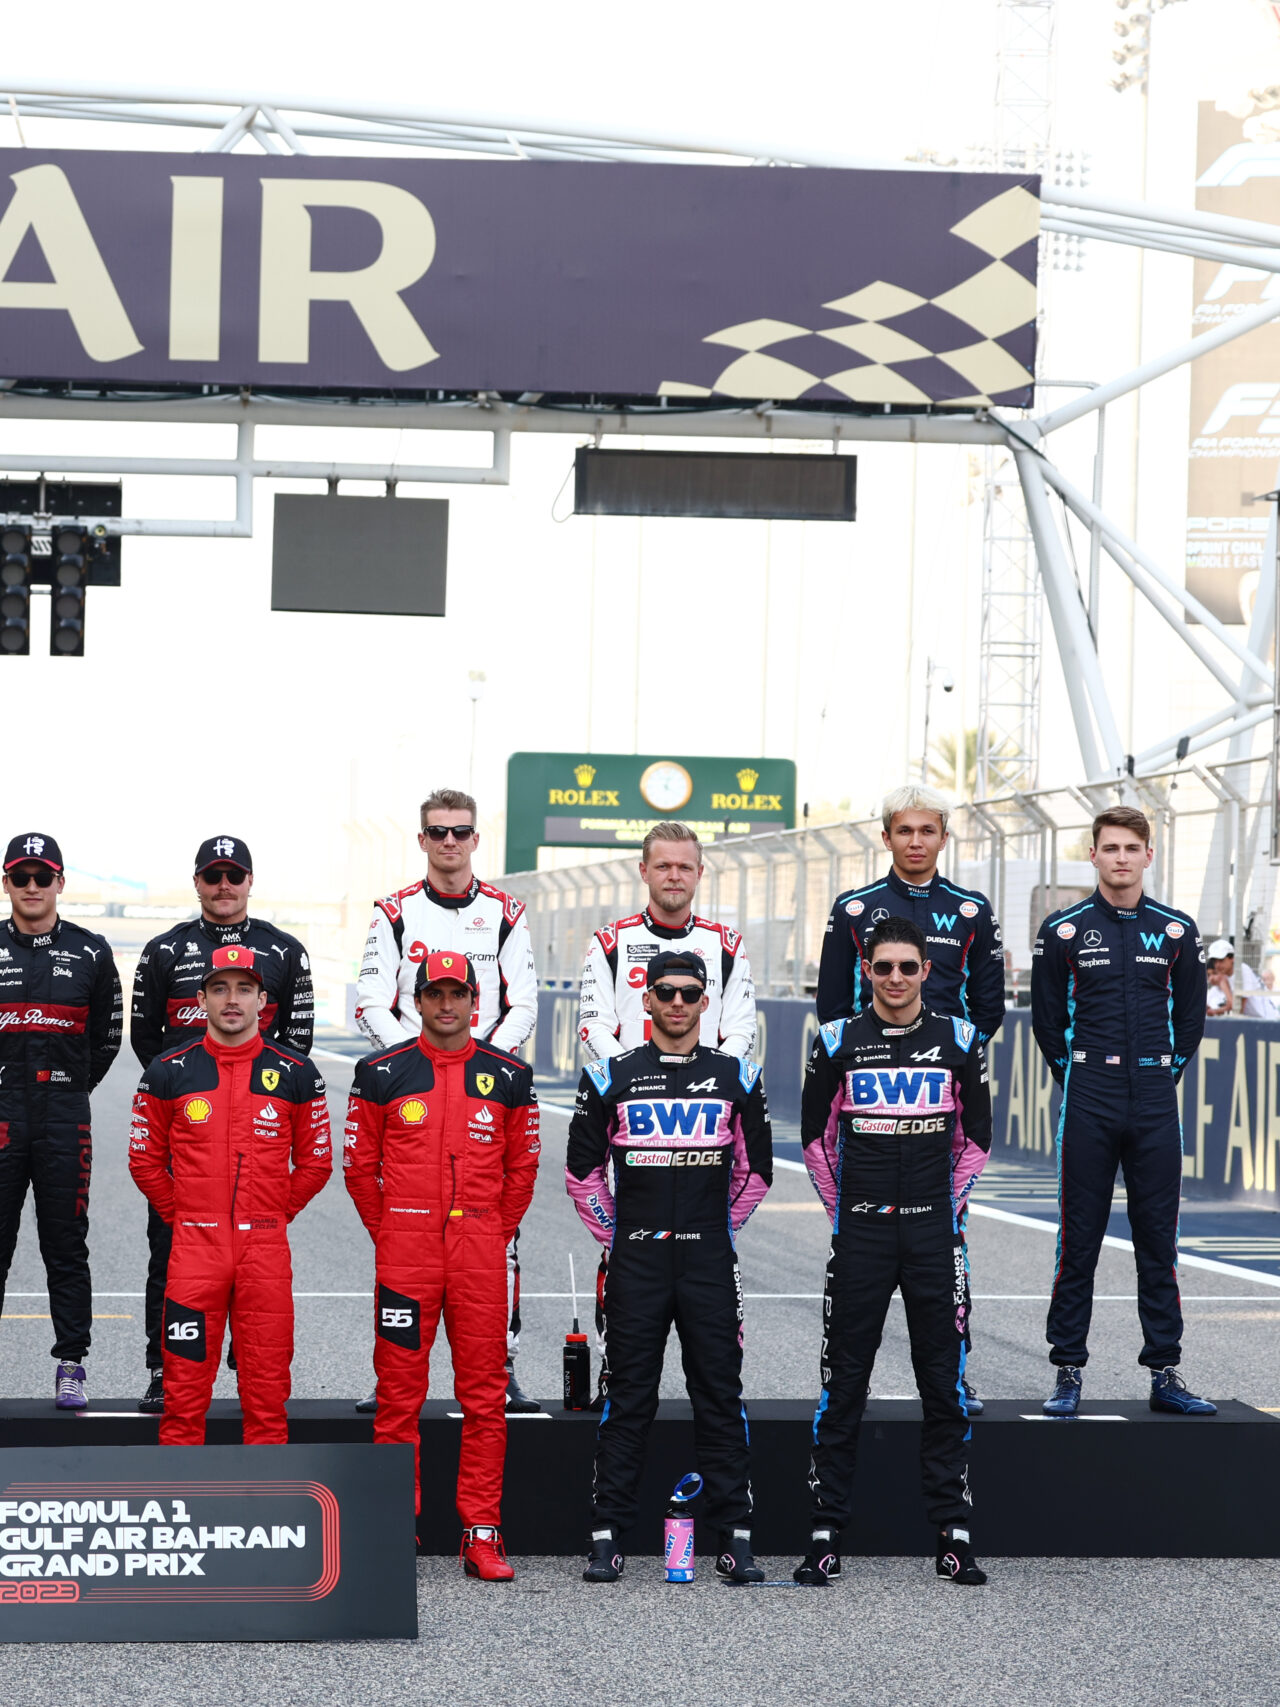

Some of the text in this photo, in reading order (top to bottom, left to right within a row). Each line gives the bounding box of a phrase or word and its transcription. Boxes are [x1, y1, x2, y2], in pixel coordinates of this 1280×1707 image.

[549, 790, 619, 806] ROLEX
[711, 794, 782, 811] ROLEX
[926, 936, 962, 946] DURACELL
[1078, 958, 1110, 968] Stephens
[1136, 956, 1169, 965] DURACELL
[24, 1008, 75, 1027] Romeo
[176, 1006, 208, 1026] Alfa
[852, 1072, 946, 1105] BWT
[253, 1118, 281, 1128] Santander
[467, 1121, 496, 1132] Santander
[627, 1103, 723, 1136] BWT
[861, 1117, 946, 1134] Castrol EDGE
[254, 1128, 278, 1137] CEVA
[469, 1132, 493, 1141] CEVA
[634, 1151, 723, 1166] Castrol EDGE
[592, 1204, 614, 1230] BWT
[899, 1205, 932, 1214] ESTEBAN
[382, 1308, 413, 1328] 55
[168, 1321, 199, 1341] 16
[172, 1500, 191, 1523] 1
[89, 1527, 146, 1549] AIR
[152, 1525, 306, 1549] BAHRAIN
[124, 1552, 206, 1576] PRIX
